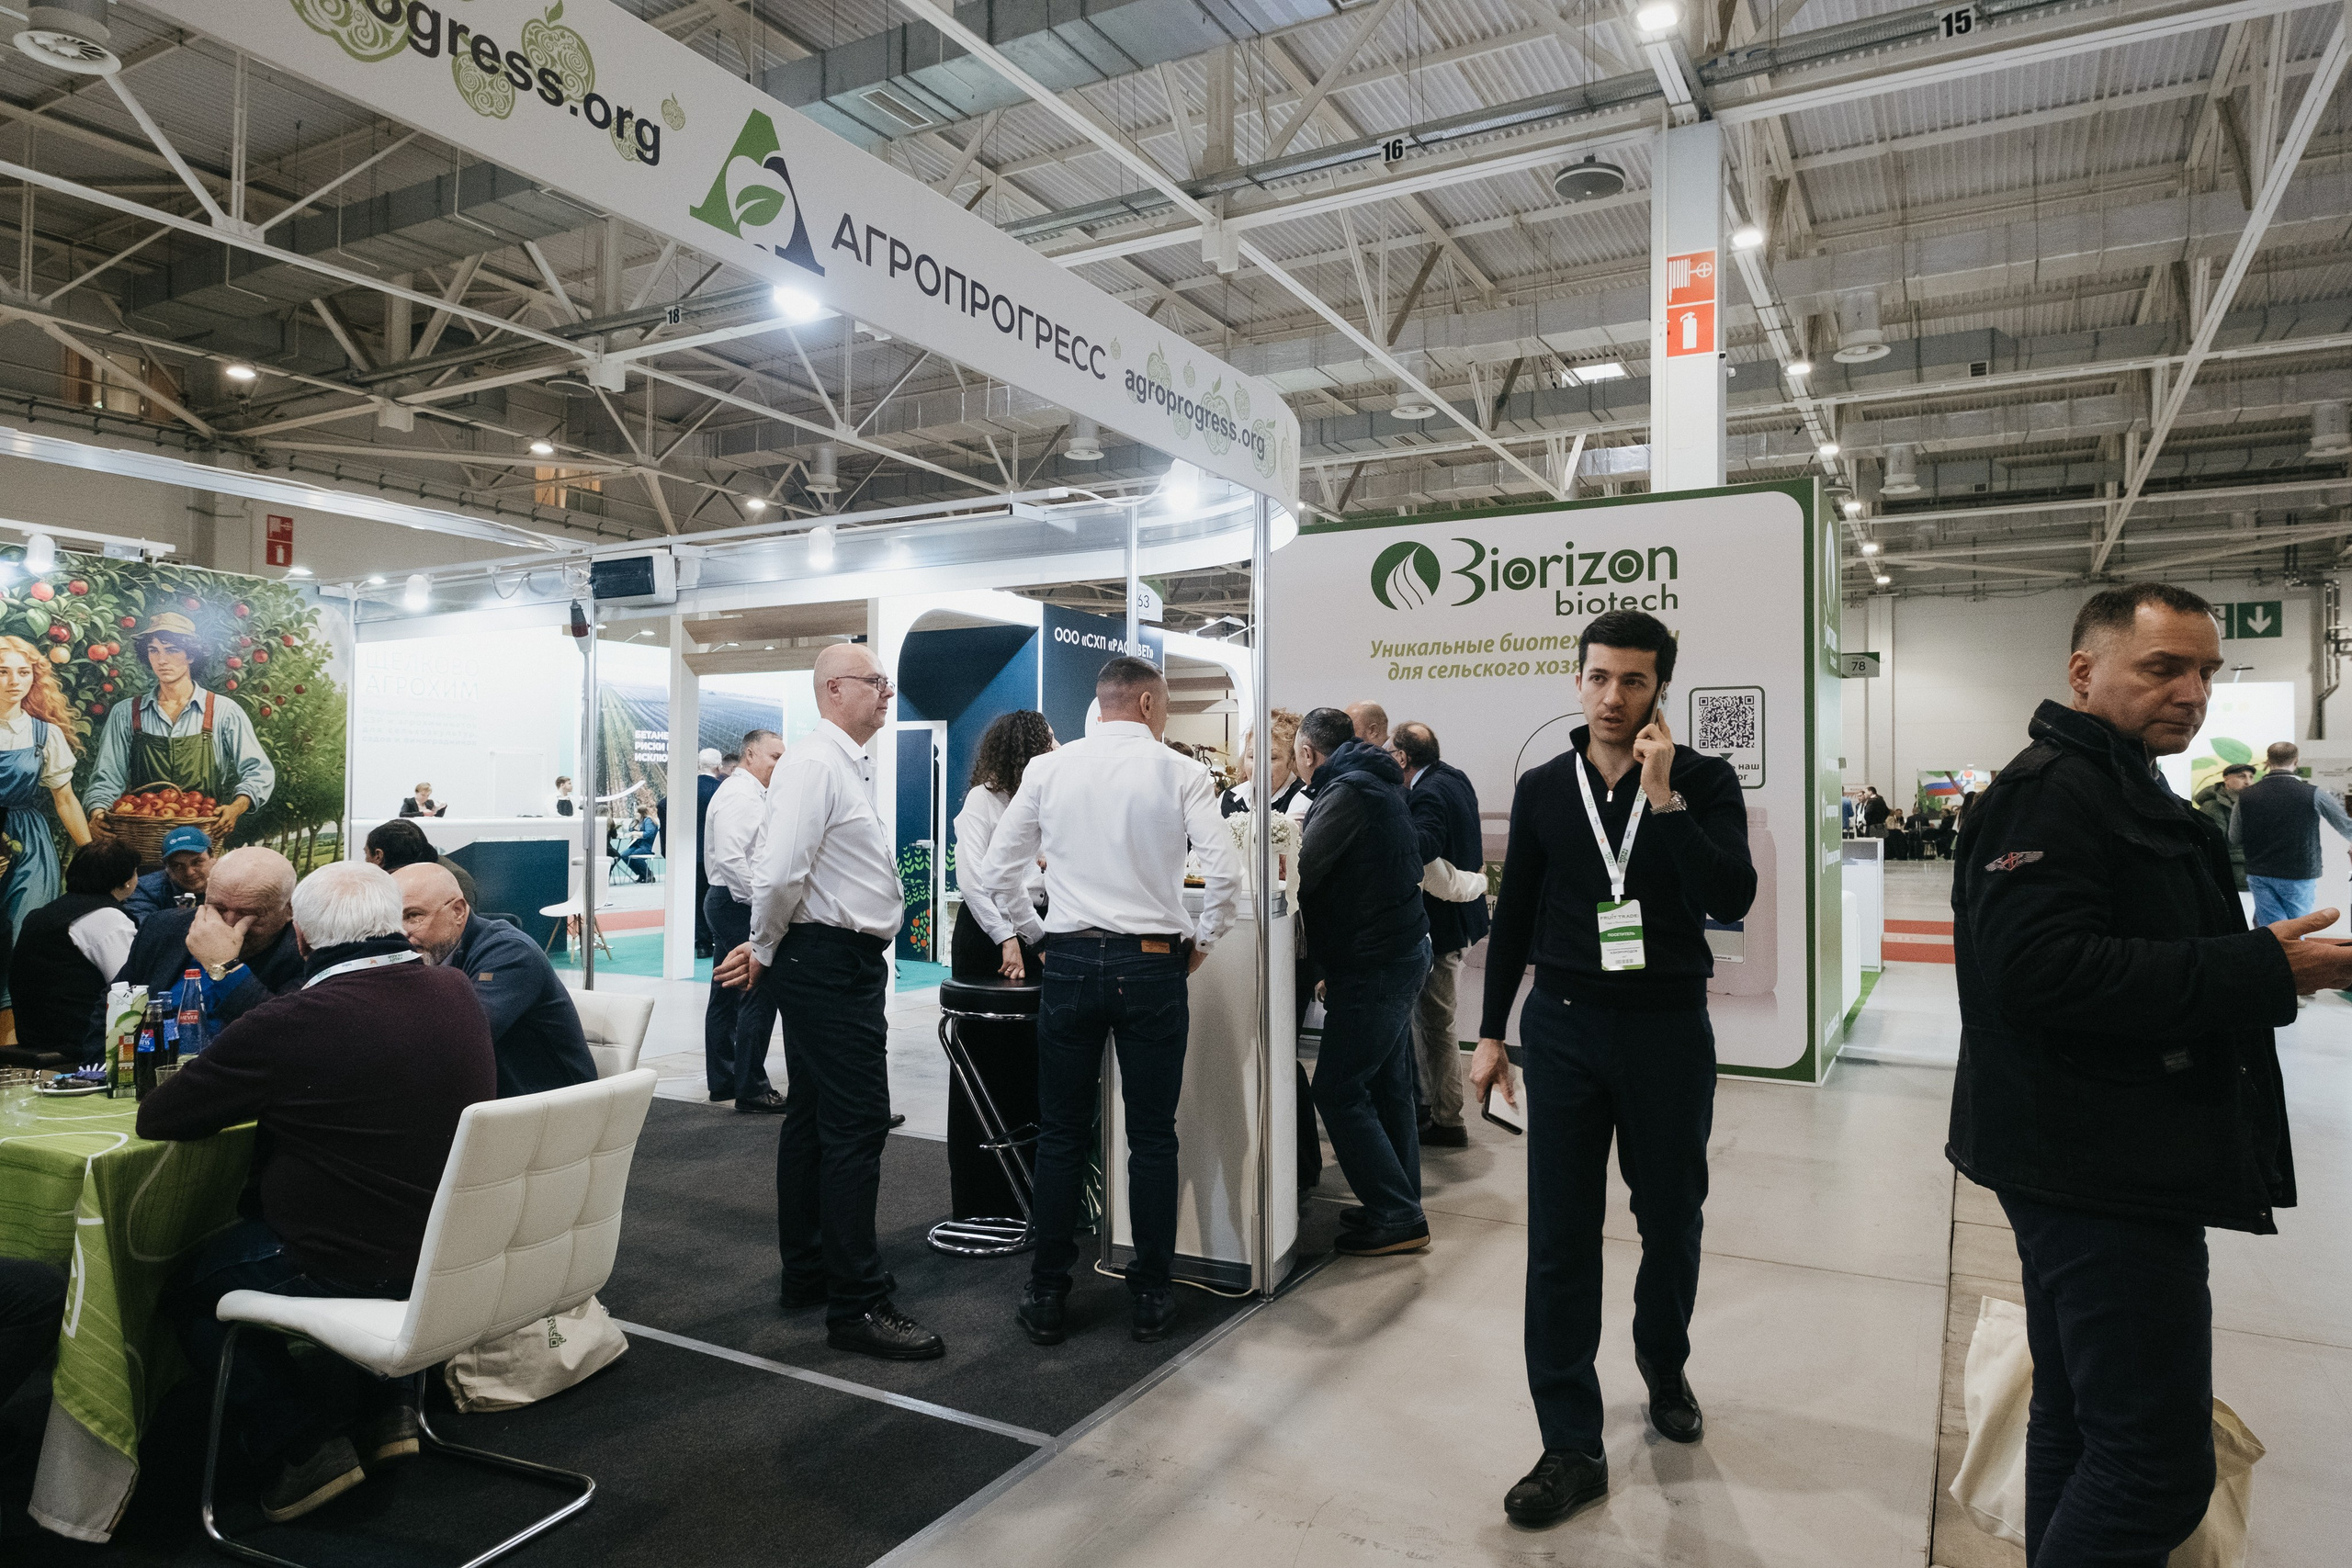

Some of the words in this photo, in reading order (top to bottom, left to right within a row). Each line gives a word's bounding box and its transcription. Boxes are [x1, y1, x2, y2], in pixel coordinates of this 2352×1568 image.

[1940, 8, 1972, 38] 15
[343, 0, 660, 166] ogress.org
[1382, 139, 1403, 162] 16
[831, 212, 1106, 379] АГРОПРОГРЕСС
[668, 308, 680, 324] 18
[1125, 368, 1265, 460] agroprogress.org
[1451, 537, 1678, 606] Biorizon
[1555, 583, 1679, 616] biotech
[1054, 626, 1080, 645] ООО
[1081, 634, 1106, 649] «СХП
[1108, 638, 1154, 659] «РАВЕТ»
[1370, 636, 1495, 659] Уникальные
[1387, 661, 1423, 681] для
[1427, 658, 1531, 680] сельского
[1533, 658, 1580, 675] хозя
[1851, 661, 1866, 671] 78
[365, 674, 479, 699] АГРОХИМ
[635, 729, 669, 740] БЕТАНЕ
[635, 740, 666, 751] РИСКИ
[635, 752, 669, 763] ИСКЛЮ
